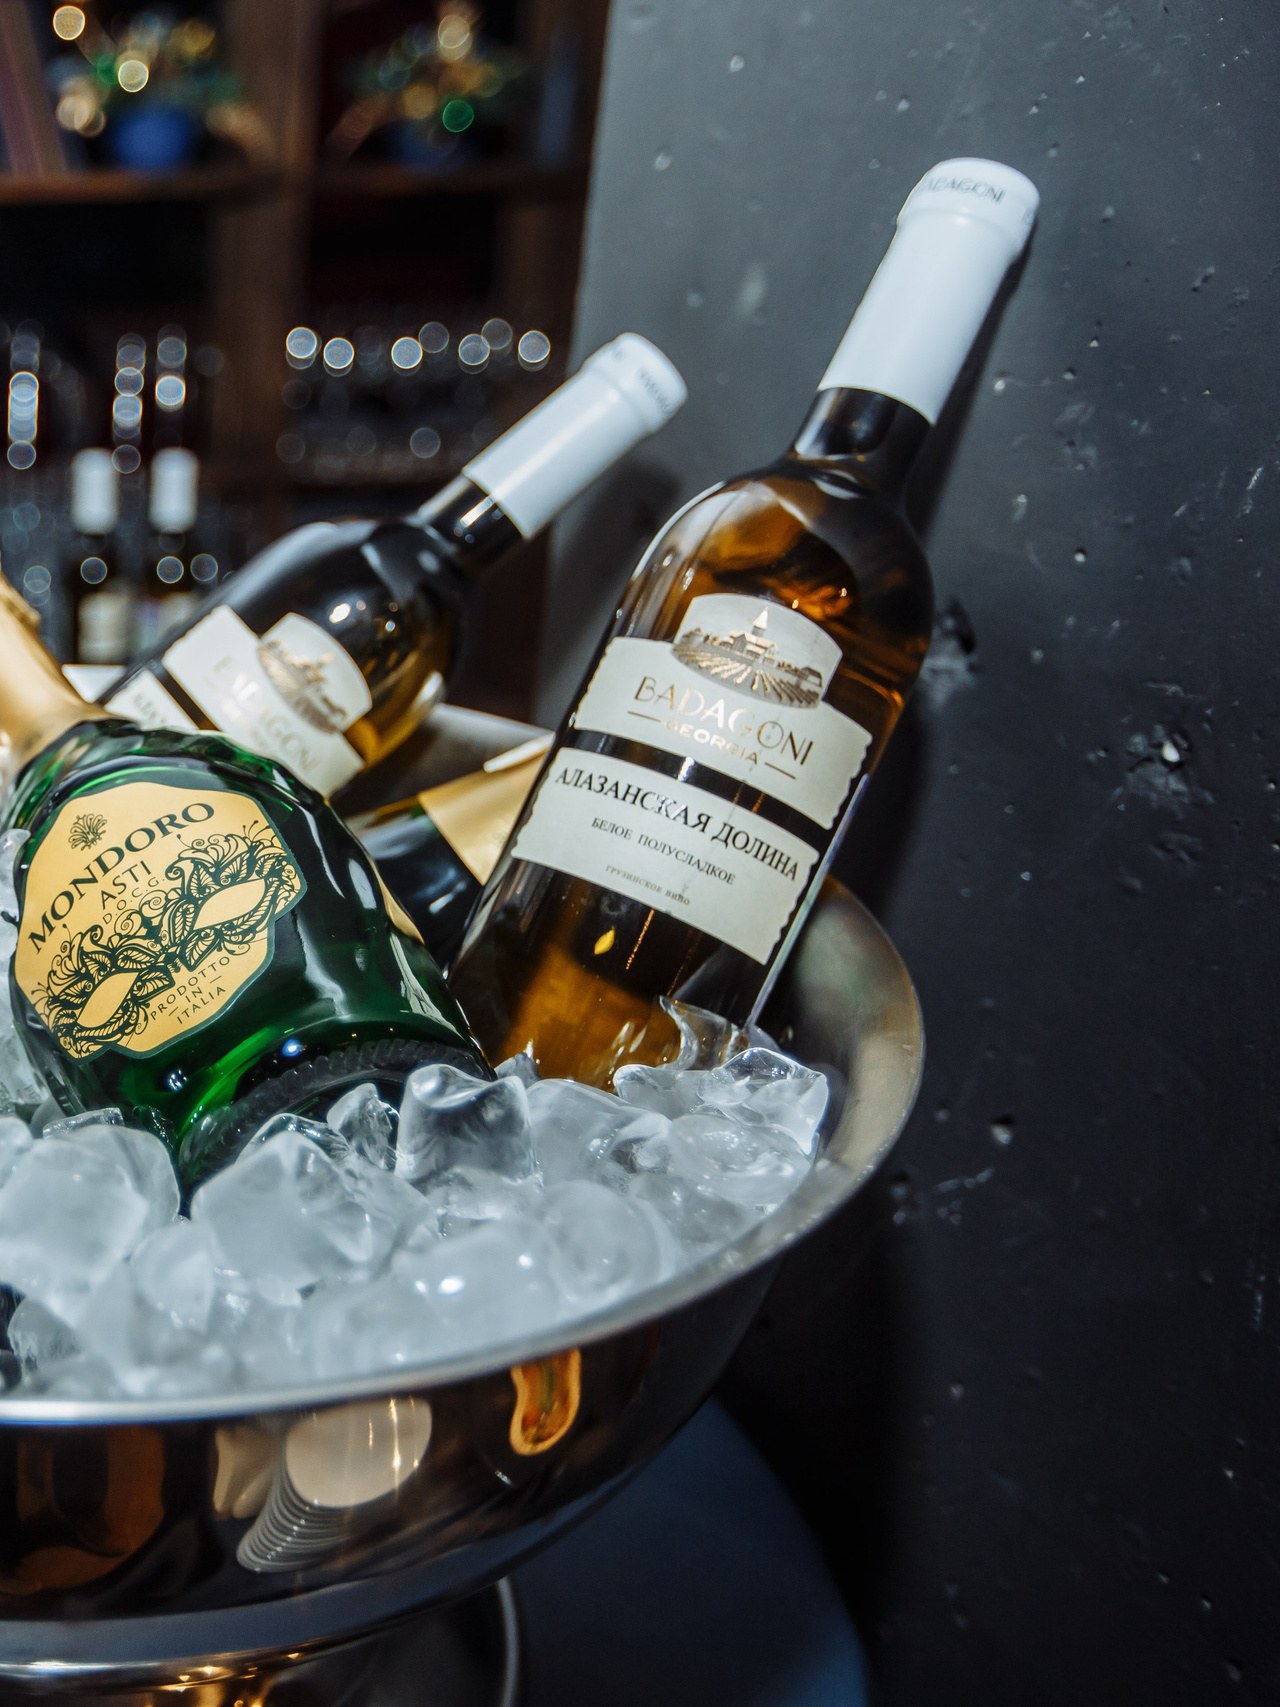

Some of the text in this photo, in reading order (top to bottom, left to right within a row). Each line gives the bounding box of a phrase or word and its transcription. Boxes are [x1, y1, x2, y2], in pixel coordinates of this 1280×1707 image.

[634, 676, 814, 765] BADAGONI
[664, 718, 759, 765] GEORGIA
[555, 767, 800, 883] АЛАЗАНСКАЯ ДОЛИНА
[591, 817, 736, 885] БЕЛОЕ ПОЛУСЛАДКОЕ
[27, 802, 215, 954] MONDORO
[101, 860, 152, 911] ASTI
[150, 956, 230, 1021] PRODOTTO
[176, 986, 226, 1024] ITALIA
[185, 986, 203, 1003] IN
